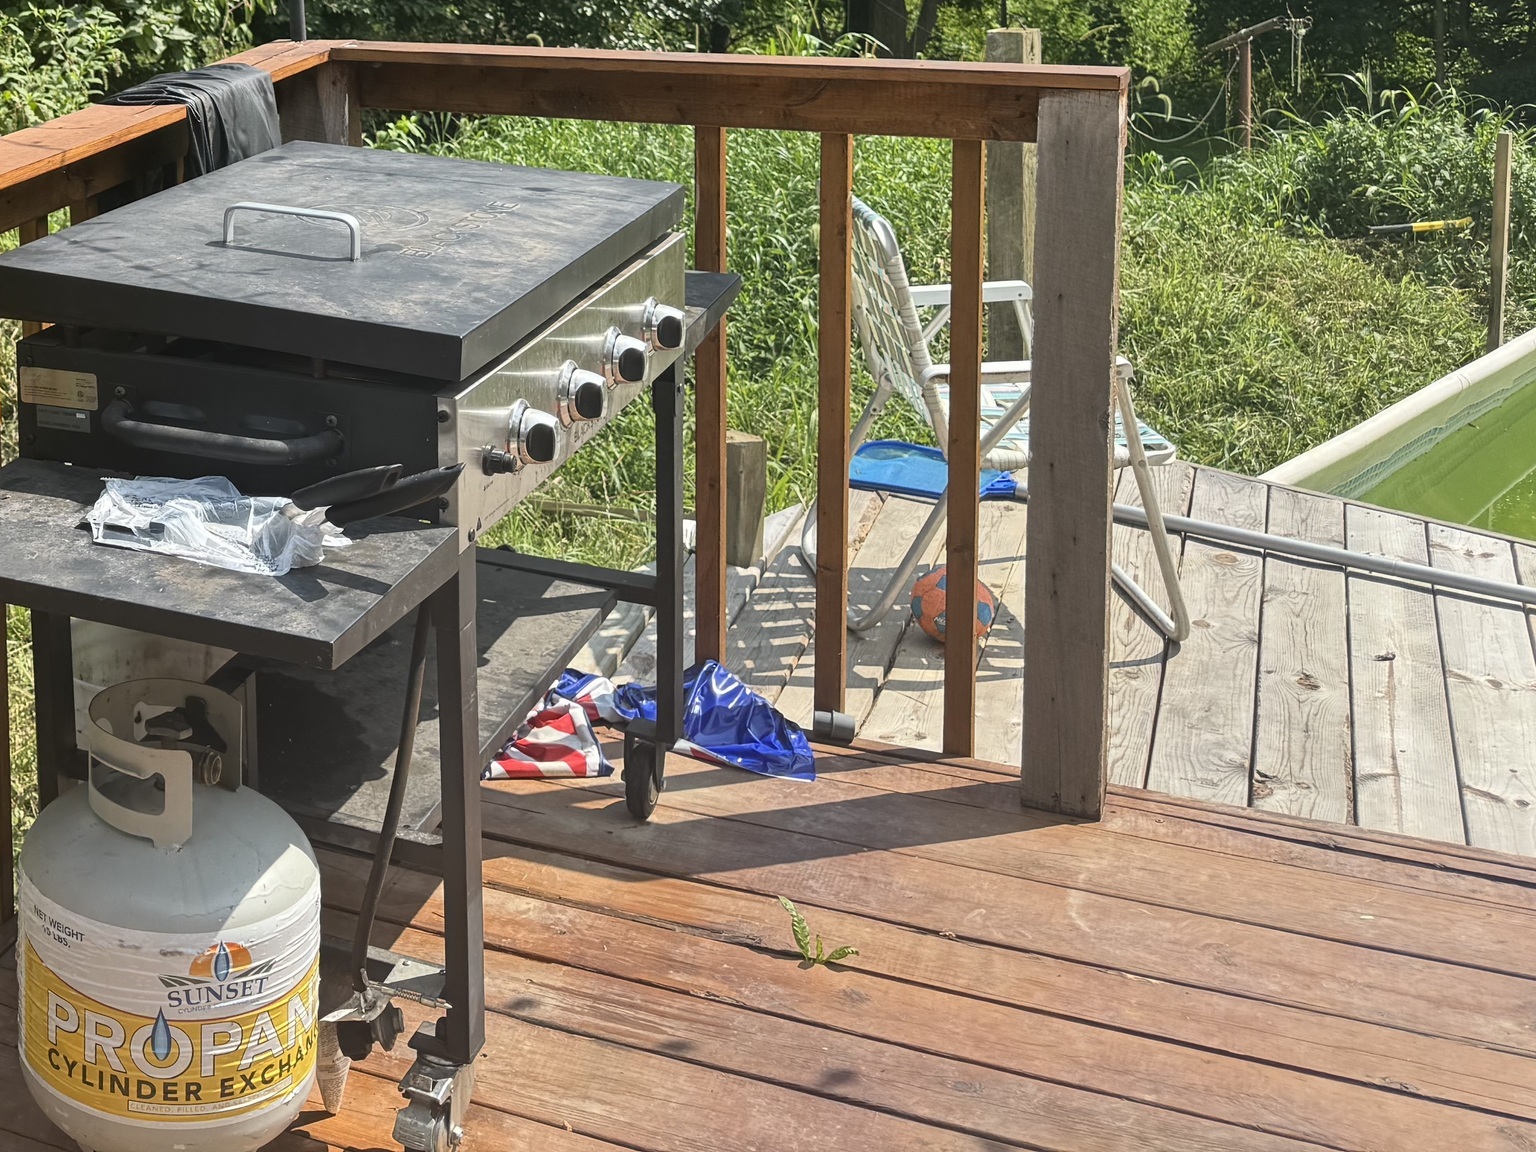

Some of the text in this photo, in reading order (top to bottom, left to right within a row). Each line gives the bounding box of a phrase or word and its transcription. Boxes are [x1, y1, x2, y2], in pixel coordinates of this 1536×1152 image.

[49, 916, 85, 943] WEIGHT
[167, 977, 269, 1008] SUNSET
[47, 978, 320, 1079] PROPAN
[47, 1048, 202, 1102] CYLINDER
[220, 1018, 318, 1098] EXCHAN
